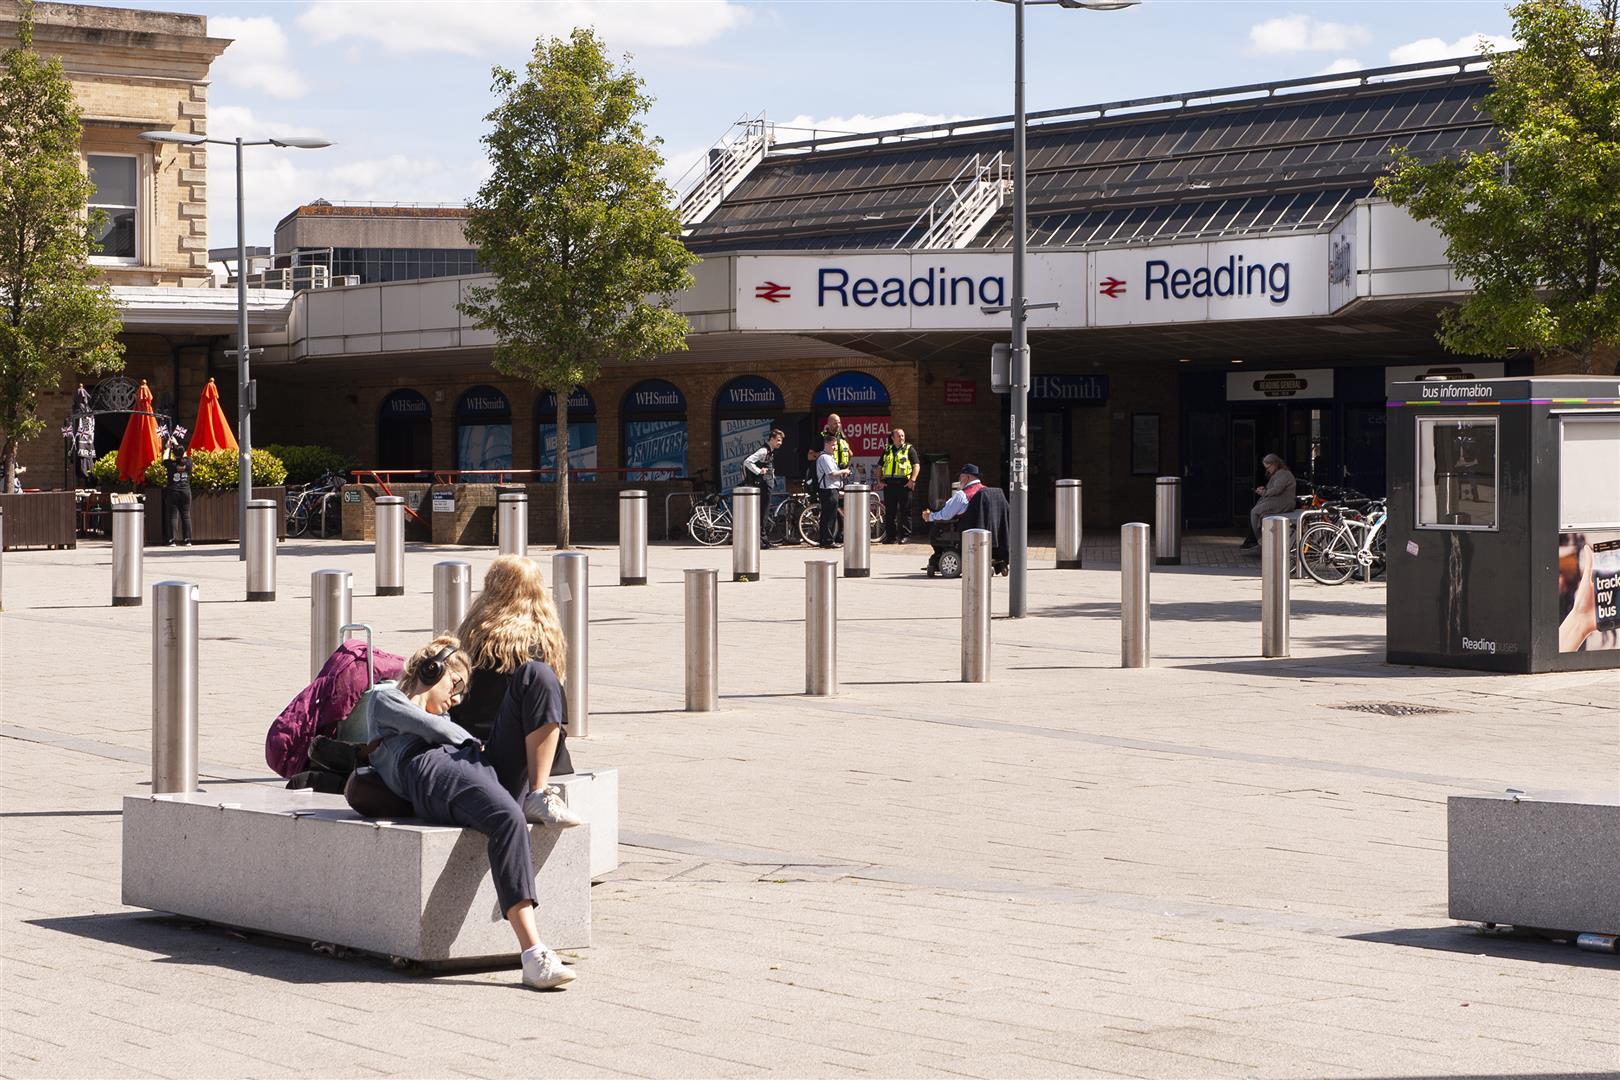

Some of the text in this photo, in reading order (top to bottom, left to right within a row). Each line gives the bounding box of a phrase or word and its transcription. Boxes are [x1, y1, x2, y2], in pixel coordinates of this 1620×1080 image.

[1145, 254, 1290, 303] Reading
[818, 267, 1004, 313] Reading
[729, 388, 775, 402] WHSmith
[826, 386, 876, 401] WHSmith
[1031, 376, 1101, 399] HSmith
[1422, 384, 1493, 398] bus information
[391, 399, 426, 412] WHSmith
[466, 396, 505, 410] WHSmith
[548, 394, 589, 407] WSmith
[635, 391, 679, 406] WHSmith
[863, 423, 892, 435] MEAL
[634, 431, 682, 461] SNICKERS
[1597, 590, 1613, 605] my
[1598, 605, 1617, 619] bus
[1462, 637, 1496, 654] Reading
